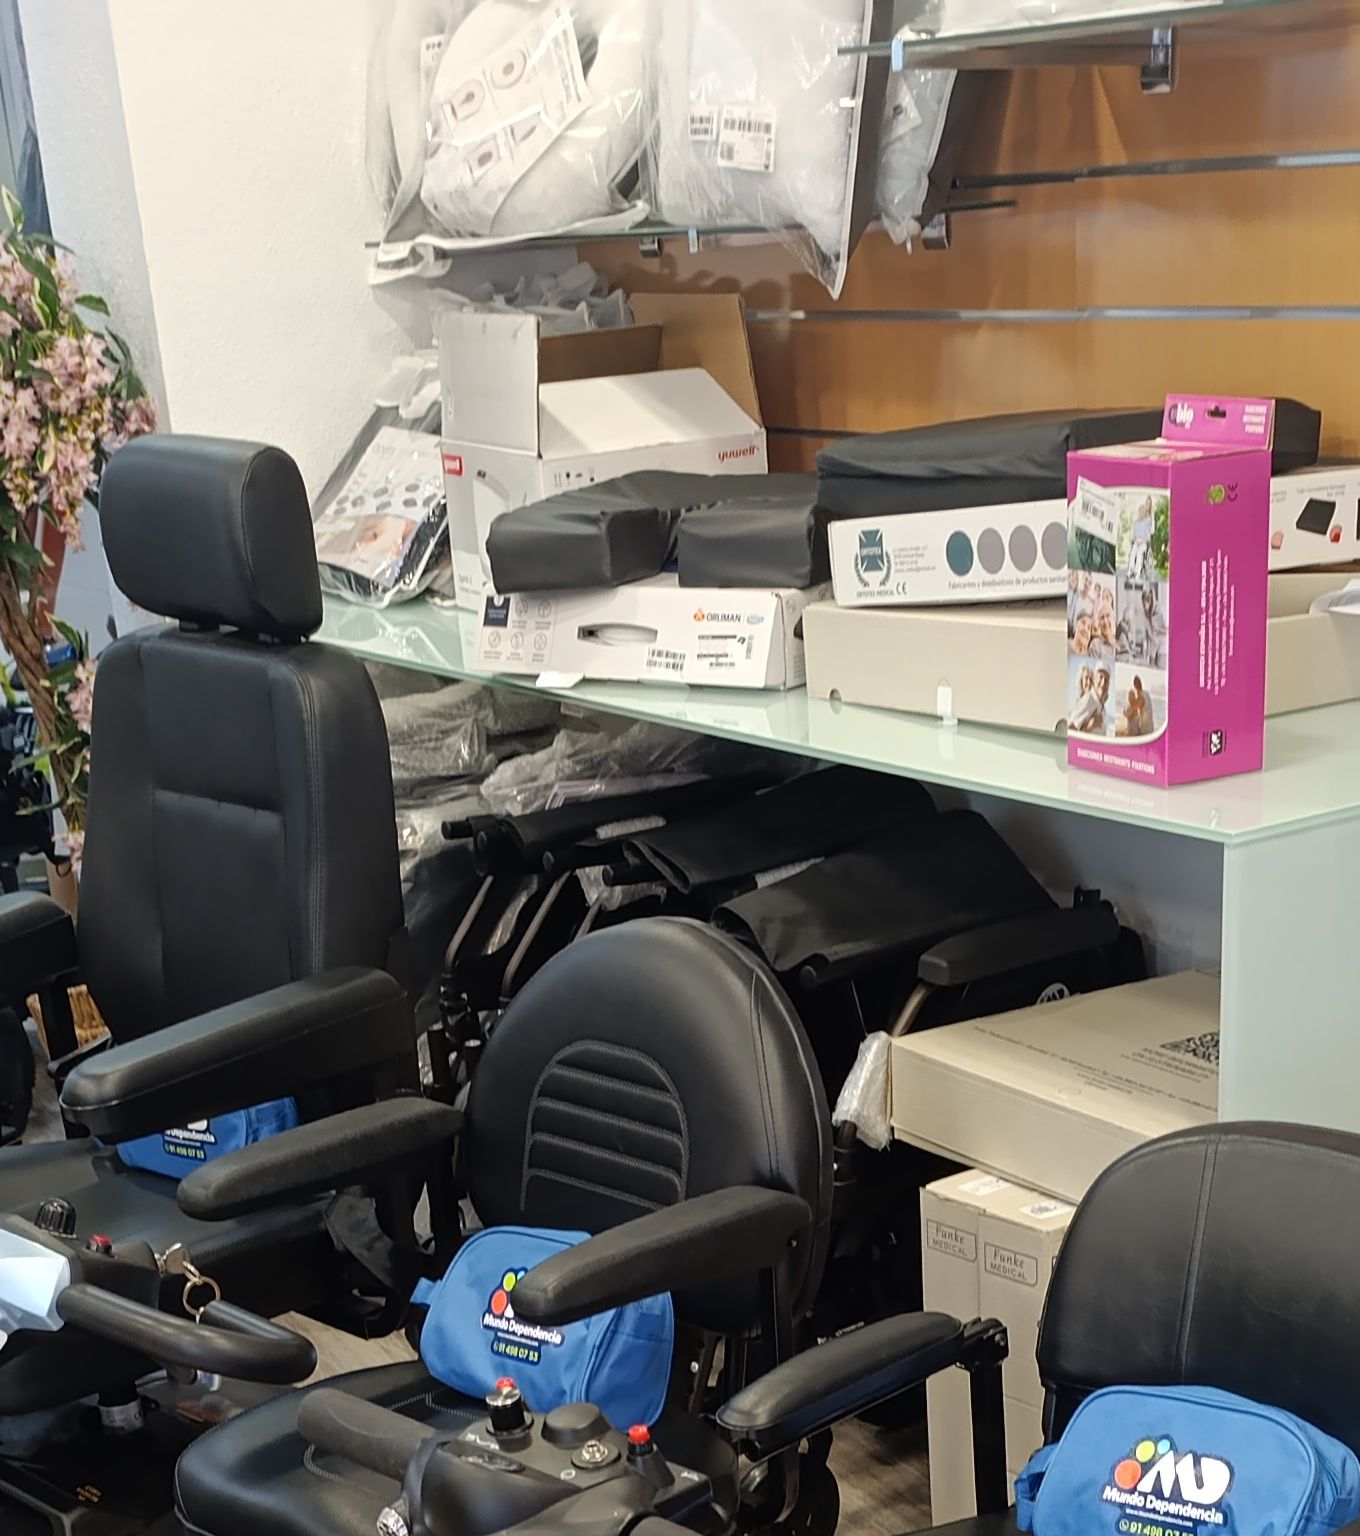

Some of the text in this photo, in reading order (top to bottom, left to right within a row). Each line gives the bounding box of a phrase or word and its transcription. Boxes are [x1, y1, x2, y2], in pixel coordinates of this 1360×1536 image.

[718, 443, 757, 463] yuwell
[934, 1224, 966, 1246] Funke
[932, 1236, 968, 1258] MEDICAL
[992, 1247, 1026, 1269] Funke
[989, 1261, 1029, 1283] MEDICAL
[483, 1313, 510, 1332] Mundo
[509, 1319, 563, 1344] Dependencia
[1103, 1485, 1224, 1525] Mundo Dependencia
[1129, 1520, 1142, 1534] 91
